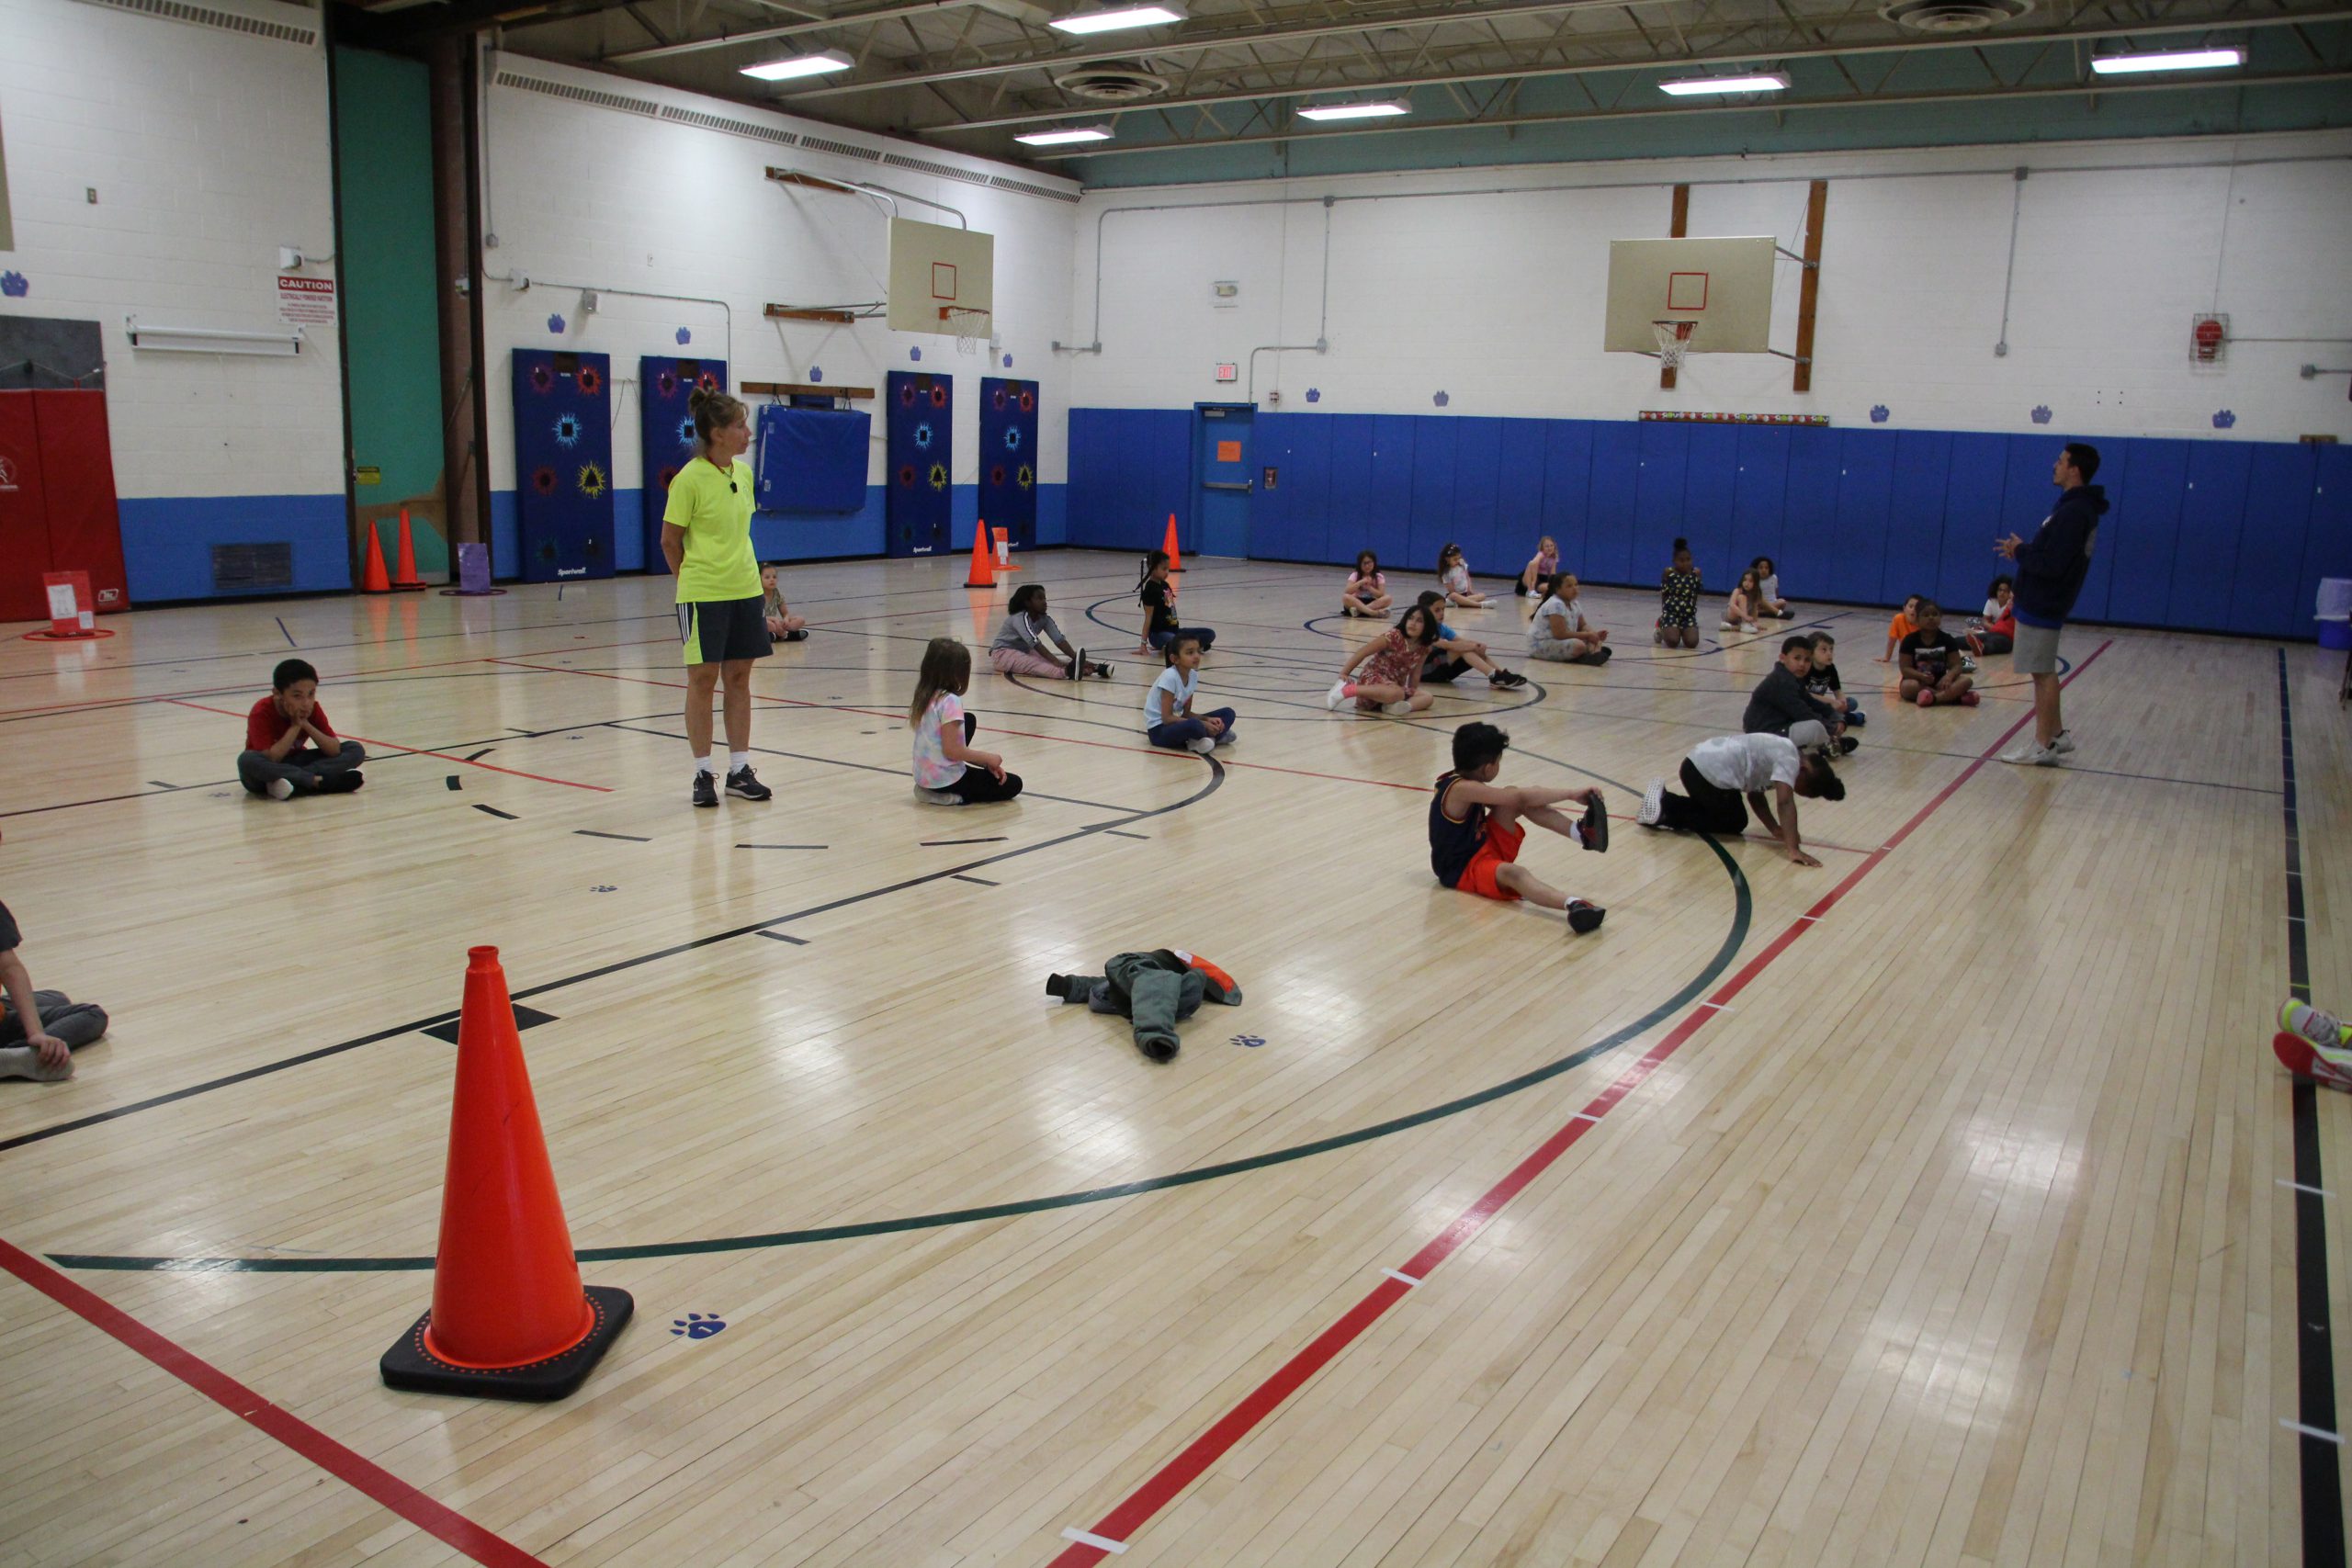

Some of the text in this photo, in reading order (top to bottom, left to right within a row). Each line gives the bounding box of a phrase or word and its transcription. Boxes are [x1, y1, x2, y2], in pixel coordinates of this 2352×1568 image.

[279, 279, 332, 290] CAUTION
[1218, 367, 1231, 378] EXIT
[558, 567, 587, 577] Sportwall
